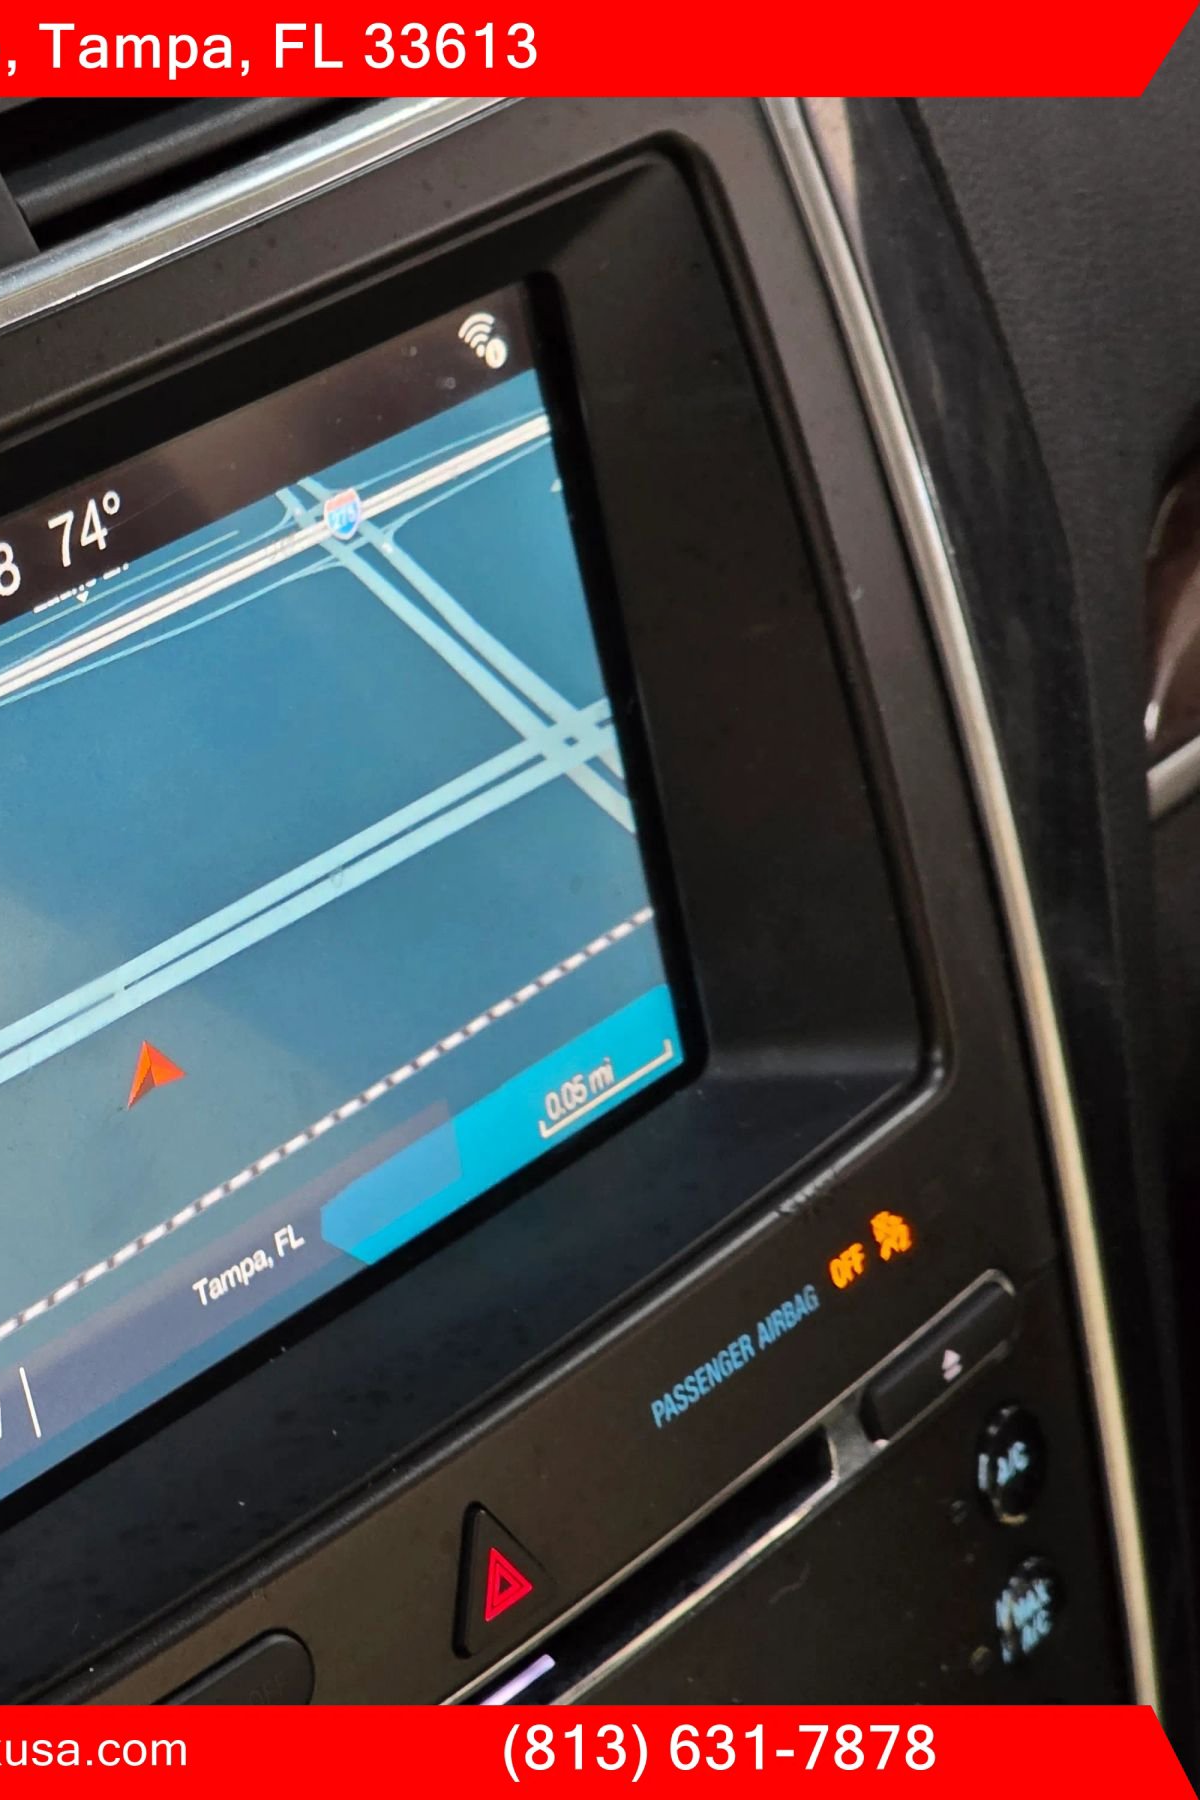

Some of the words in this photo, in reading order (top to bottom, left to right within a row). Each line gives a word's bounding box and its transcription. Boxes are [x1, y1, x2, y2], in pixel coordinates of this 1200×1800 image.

[47, 491, 120, 567] 74°
[544, 1074, 588, 1120] 0.05
[588, 1057, 615, 1093] mi
[192, 1249, 274, 1306] Tampa,
[274, 1224, 305, 1258] FL
[650, 1333, 756, 1428] PASSENGER
[757, 1283, 821, 1350] AIRBAG
[828, 1242, 865, 1289] OFF
